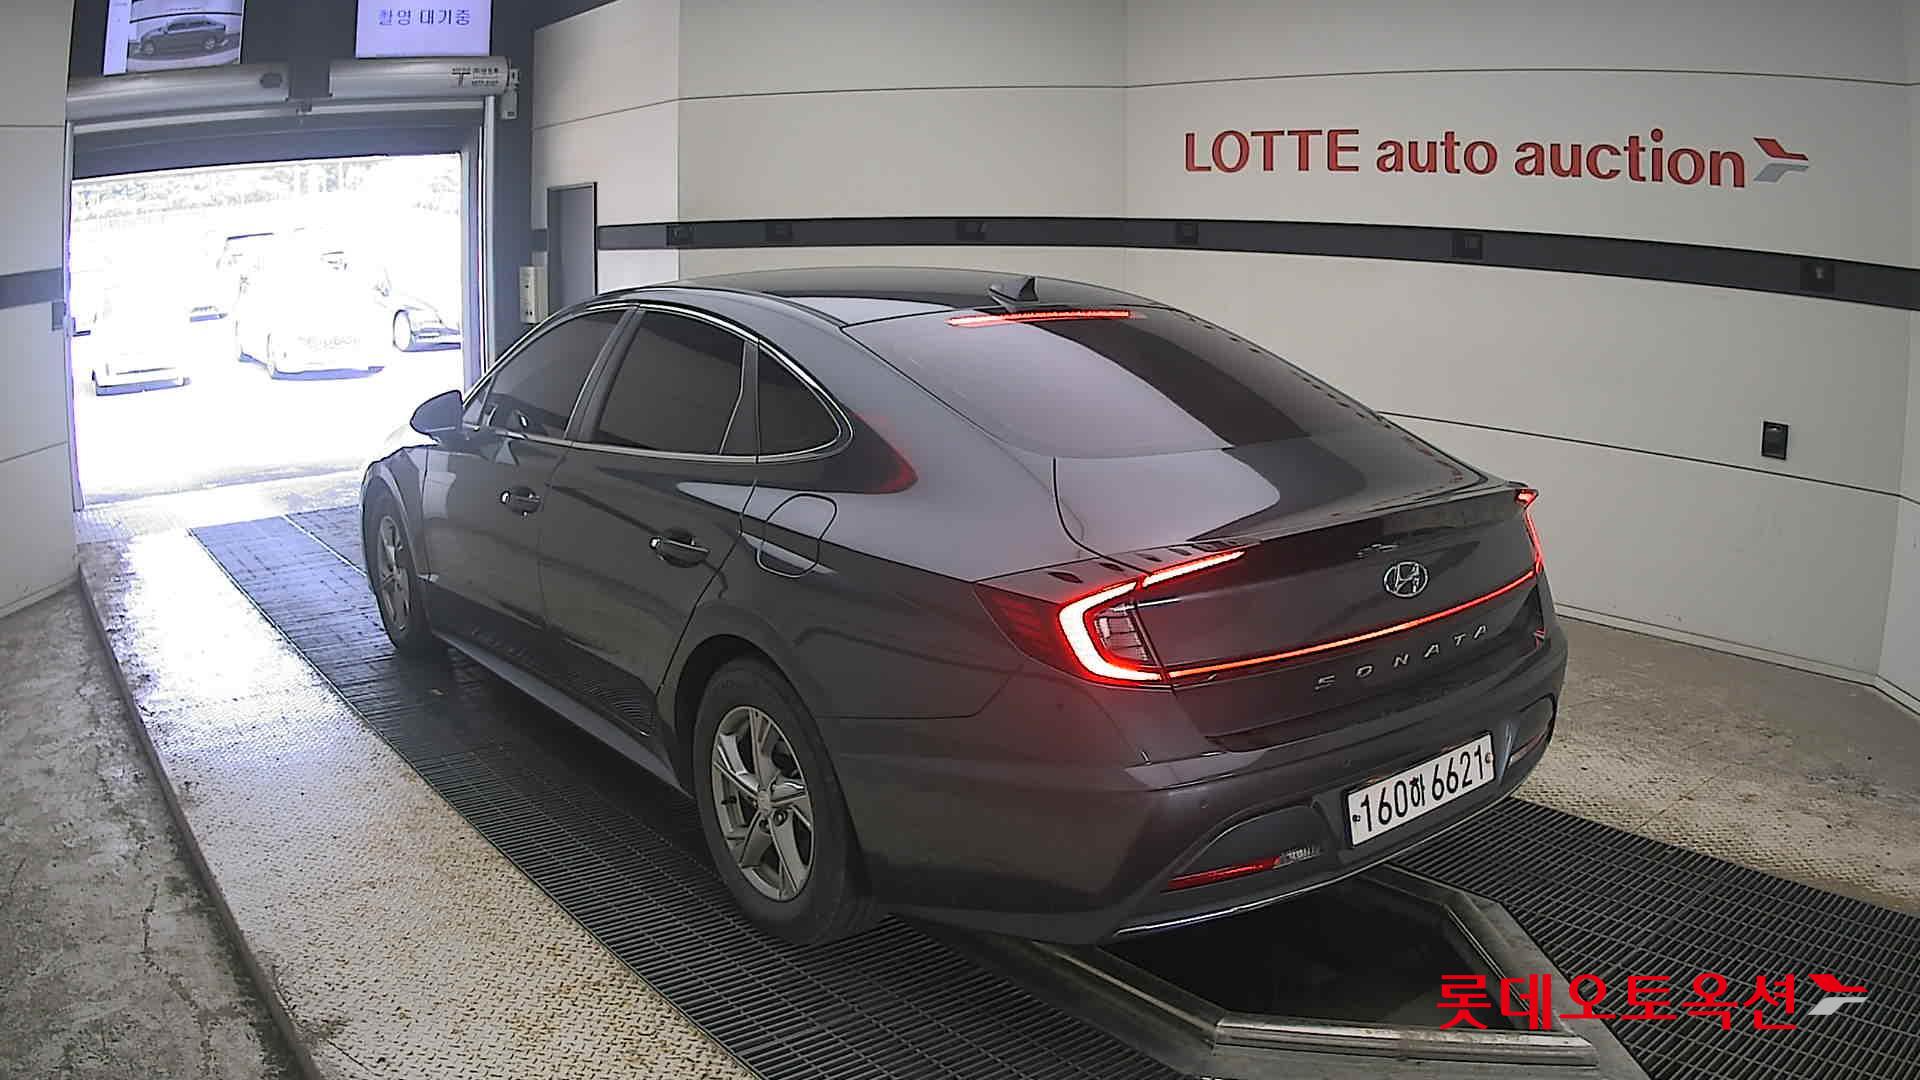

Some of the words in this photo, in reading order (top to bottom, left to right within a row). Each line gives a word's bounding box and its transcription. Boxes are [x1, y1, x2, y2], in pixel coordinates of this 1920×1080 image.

[419, 8, 471, 26] 대기중
[1184, 128, 1360, 174] LOTTE
[1376, 130, 1499, 175] auto
[1513, 127, 1746, 189] auction
[1314, 624, 1489, 690] SONATA
[1360, 773, 1426, 832] 160하
[1431, 744, 1485, 802] 6621
